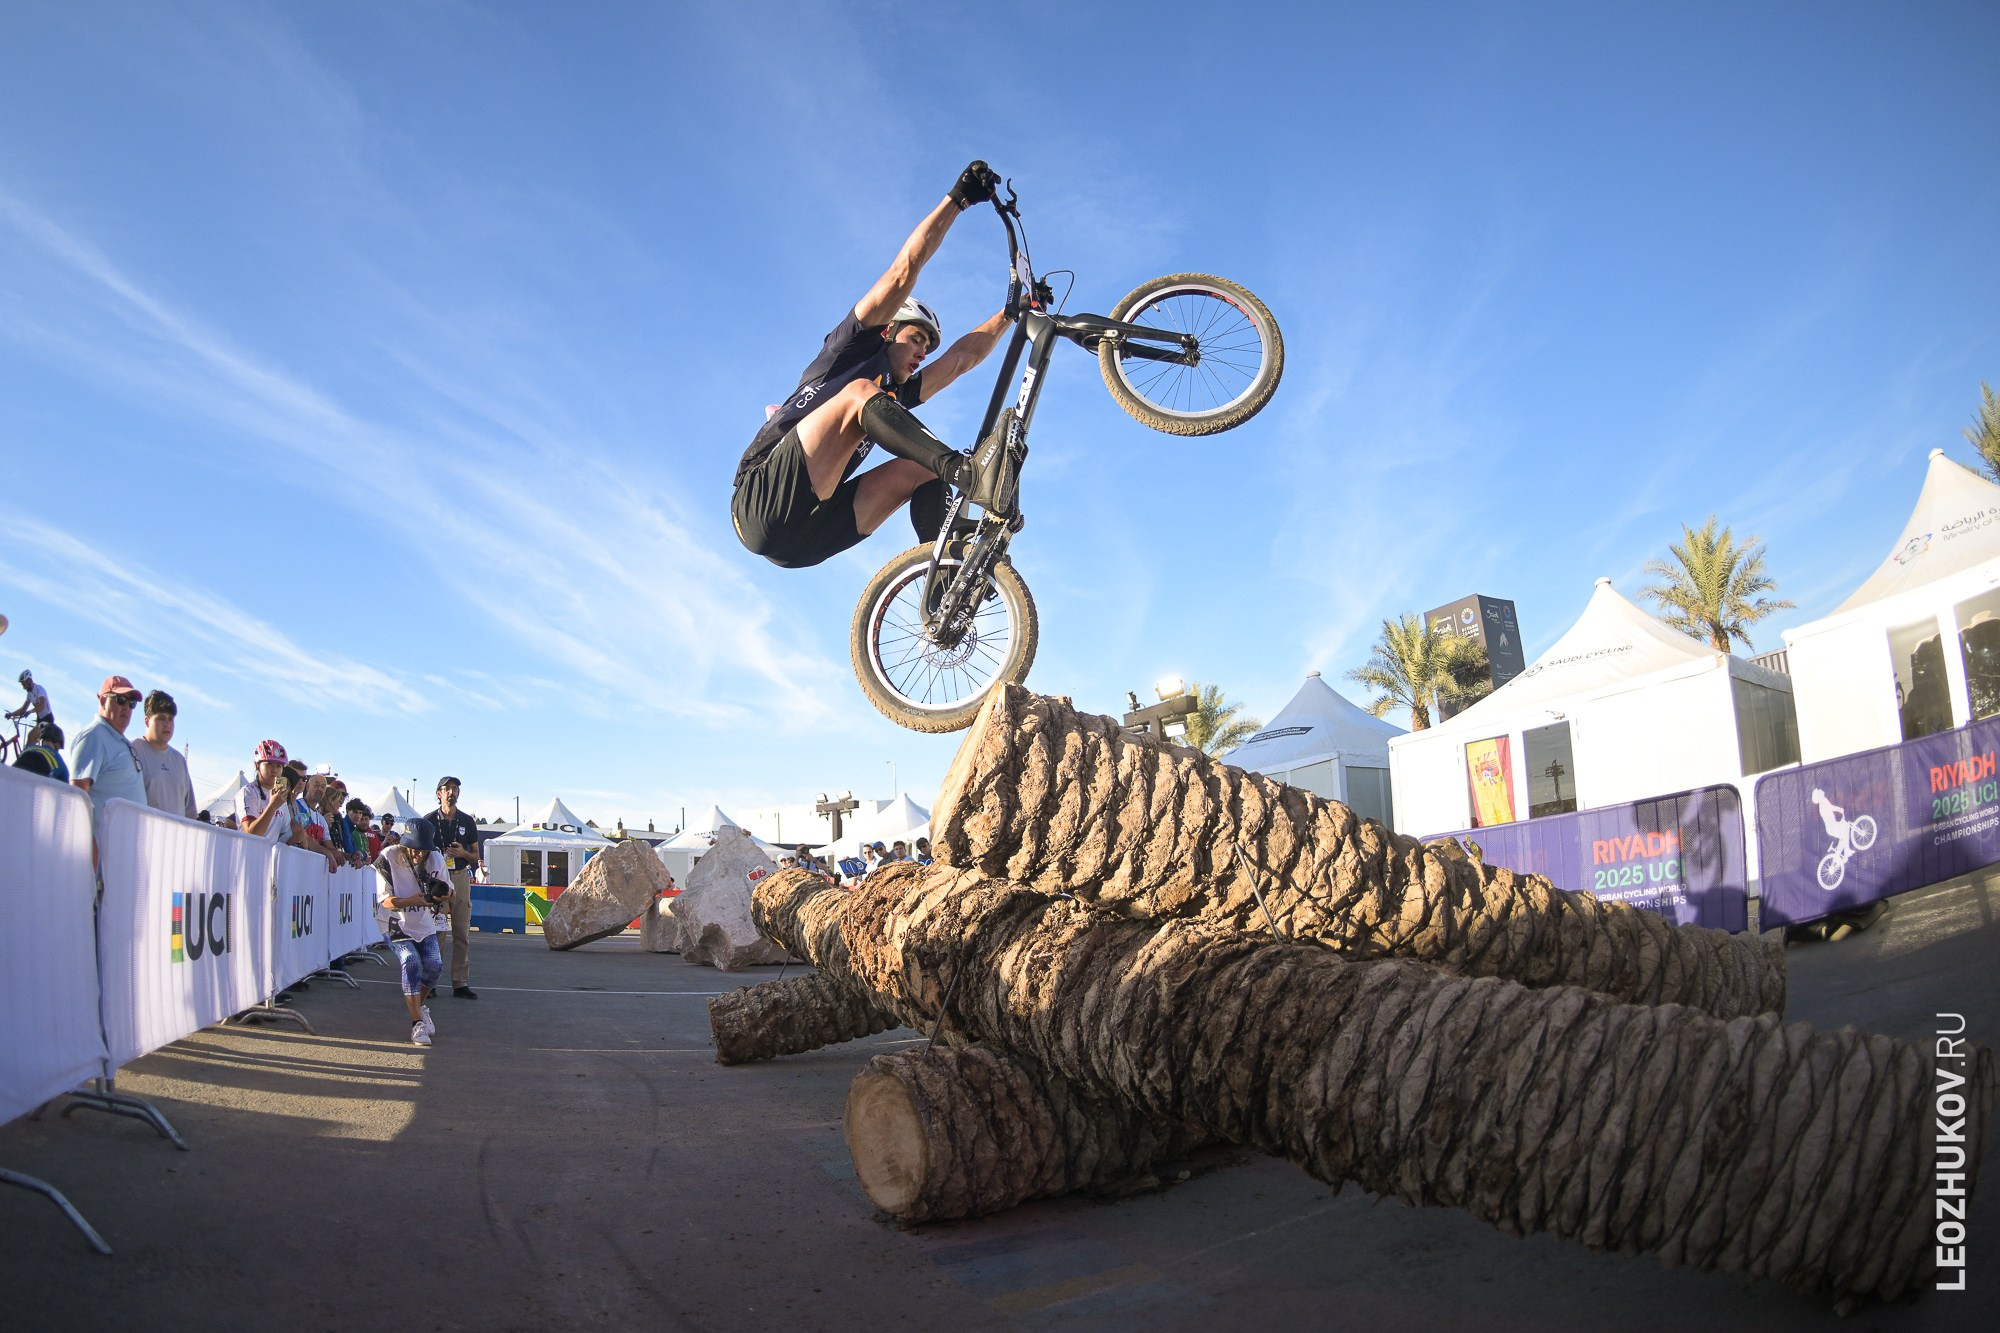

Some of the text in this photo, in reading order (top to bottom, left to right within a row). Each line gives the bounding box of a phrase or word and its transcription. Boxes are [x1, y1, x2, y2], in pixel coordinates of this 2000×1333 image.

[1548, 655, 1583, 667] SAUDI
[1930, 750, 1996, 794] RIYADH
[1932, 781, 1999, 820] 2025 UCI
[542, 822, 583, 835] UCI
[1934, 817, 2000, 846] CHAMPIONSHIPS
[1954, 811, 1980, 826] CYCLING
[1593, 828, 1684, 865] RIYADH
[1594, 858, 1687, 890] 2025 UCI
[1623, 887, 1658, 900] CYCLING
[1658, 883, 1687, 894] WORLD
[296, 894, 314, 938] UCI
[342, 892, 353, 925] UCI
[185, 892, 232, 961] UCI
